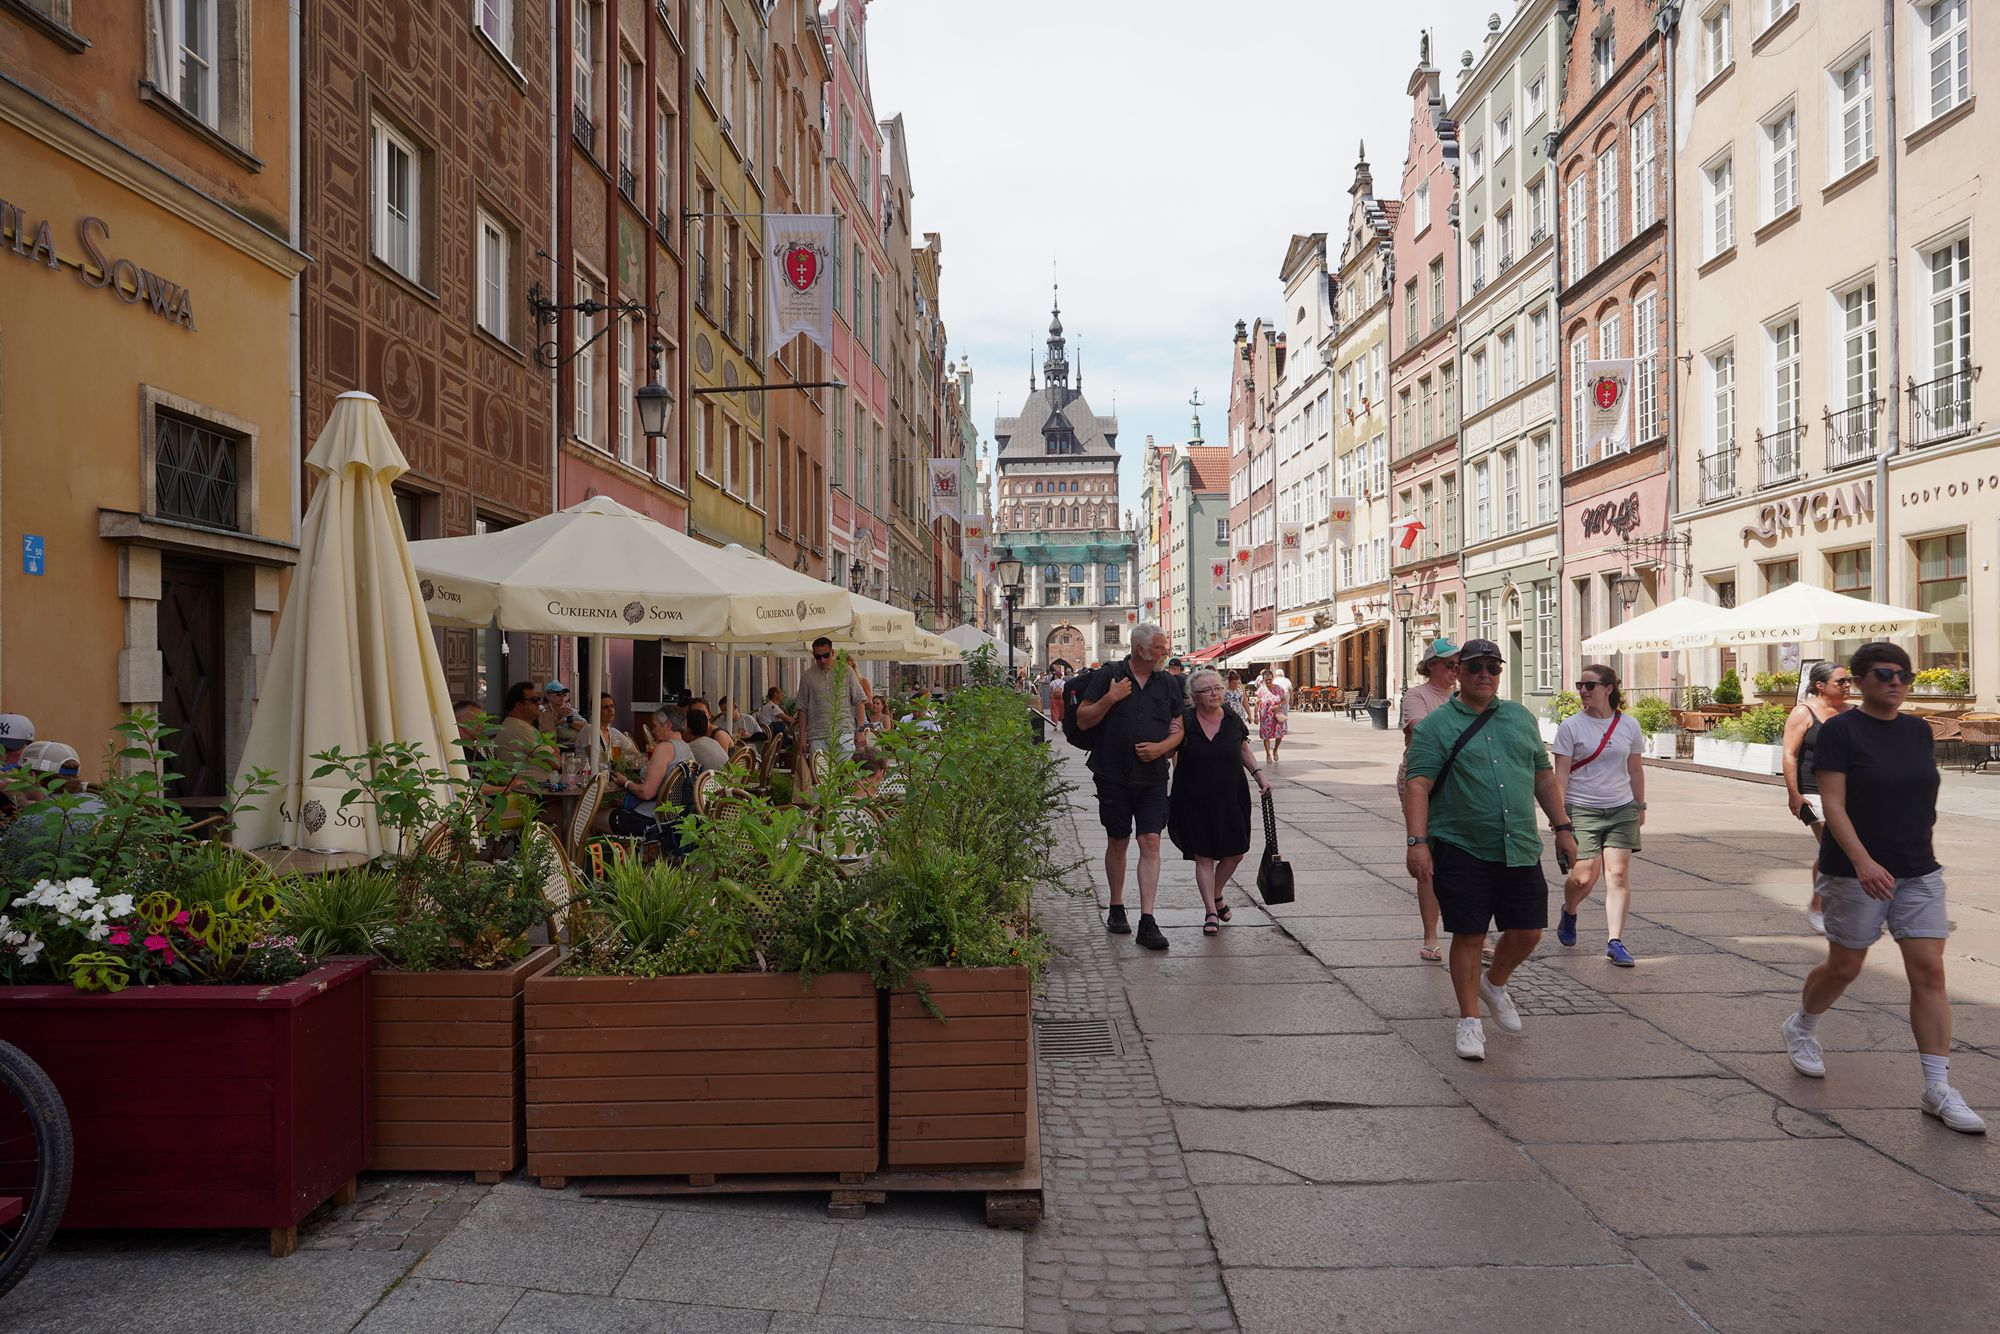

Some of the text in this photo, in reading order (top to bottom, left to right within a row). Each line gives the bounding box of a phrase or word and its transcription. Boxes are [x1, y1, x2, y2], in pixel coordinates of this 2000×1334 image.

[79, 216, 198, 332] SOWA
[1902, 486, 1940, 507] LODY
[1948, 481, 1969, 497] OD
[1740, 480, 1874, 540] GRYCAN
[547, 601, 618, 618] CUKIERNIA
[756, 605, 794, 619] CUKIERNIA
[1730, 628, 1800, 640] GRYCAN
[1832, 623, 1898, 635] GRYCAN
